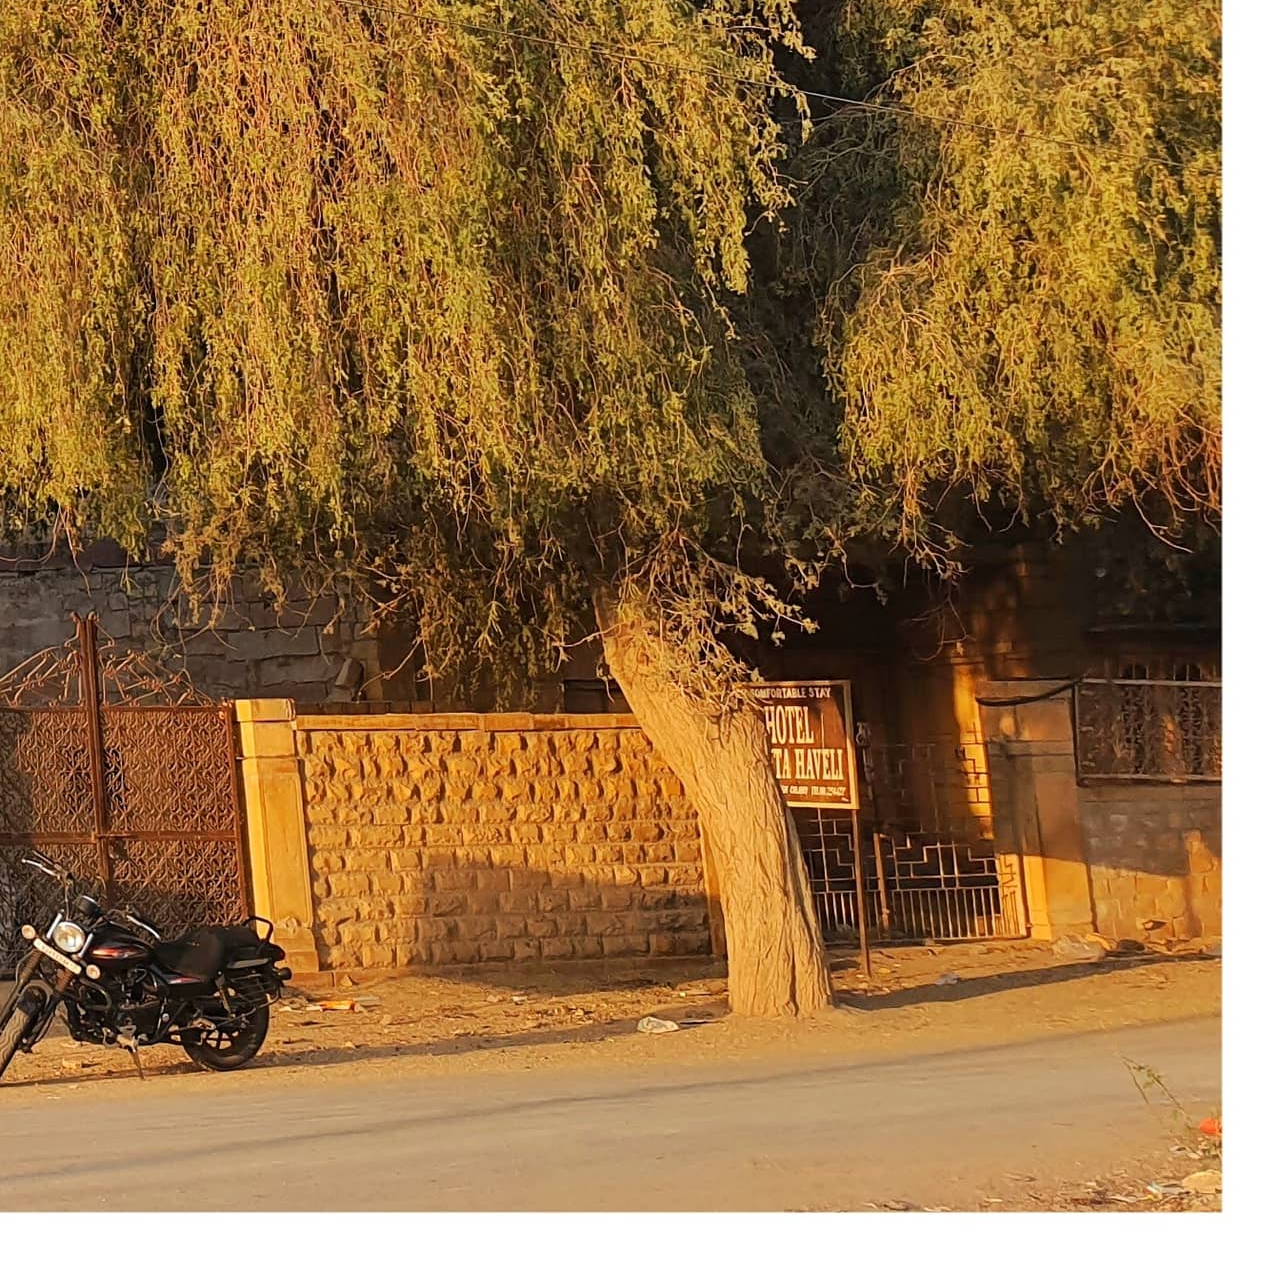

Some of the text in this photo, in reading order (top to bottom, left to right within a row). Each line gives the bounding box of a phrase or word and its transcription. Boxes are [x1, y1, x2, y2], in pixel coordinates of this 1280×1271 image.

[751, 687, 807, 699] OMFORTABLE
[808, 687, 831, 698] STAY
[764, 705, 814, 744] HOTEL
[794, 748, 844, 780] HAVELI
